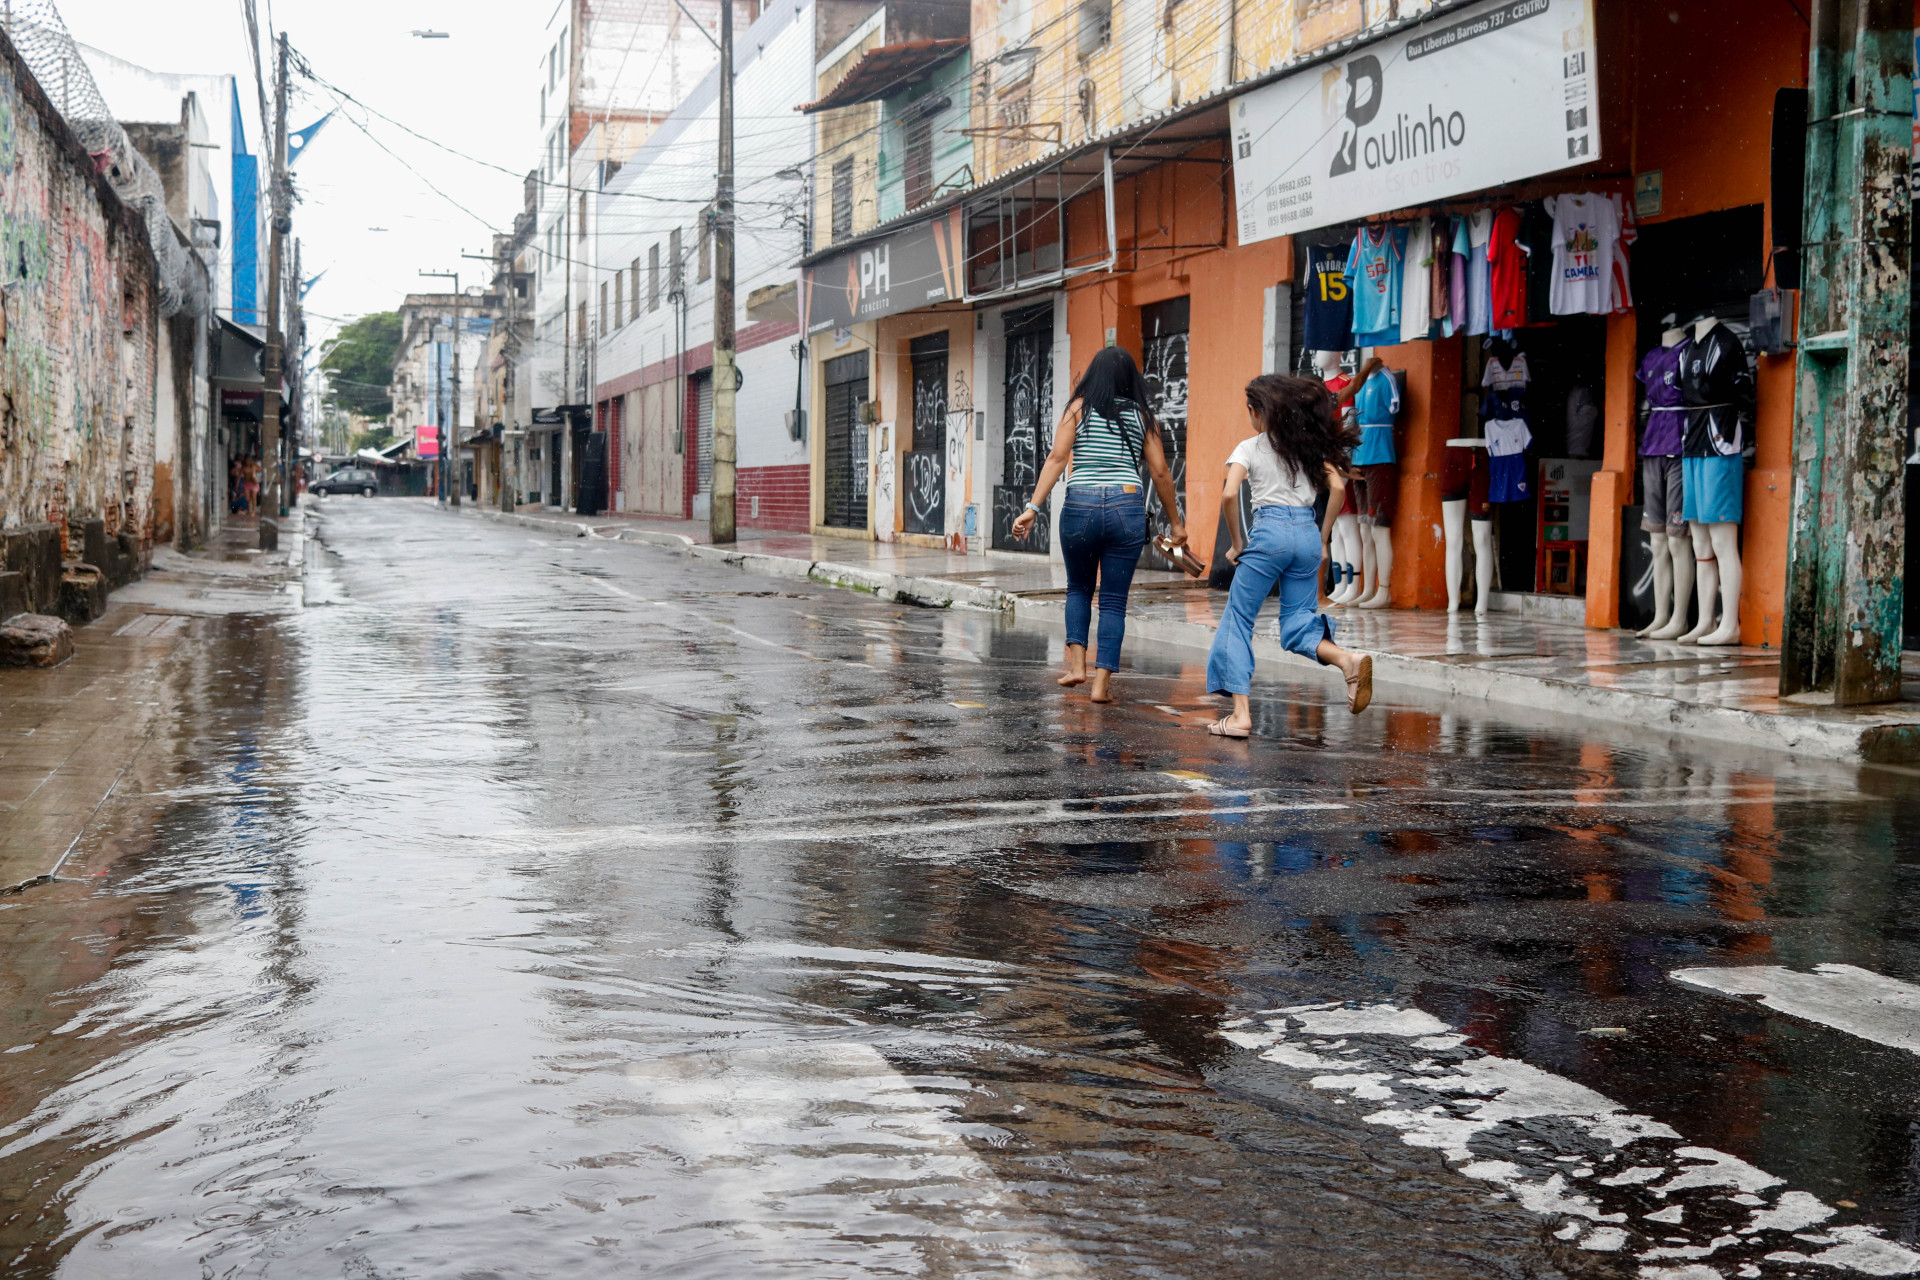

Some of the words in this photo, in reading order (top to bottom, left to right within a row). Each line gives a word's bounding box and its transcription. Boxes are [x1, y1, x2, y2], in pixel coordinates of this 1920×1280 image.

[1408, 45, 1423, 58] Rua
[1423, 32, 1456, 52] Liberato
[1456, 20, 1489, 39] Barroso
[1489, 11, 1506, 28] 737
[1511, 0, 1548, 19] CENTRO
[860, 244, 890, 299] PH
[1318, 272, 1347, 301] 15
[861, 298, 890, 314] CONCEITO
